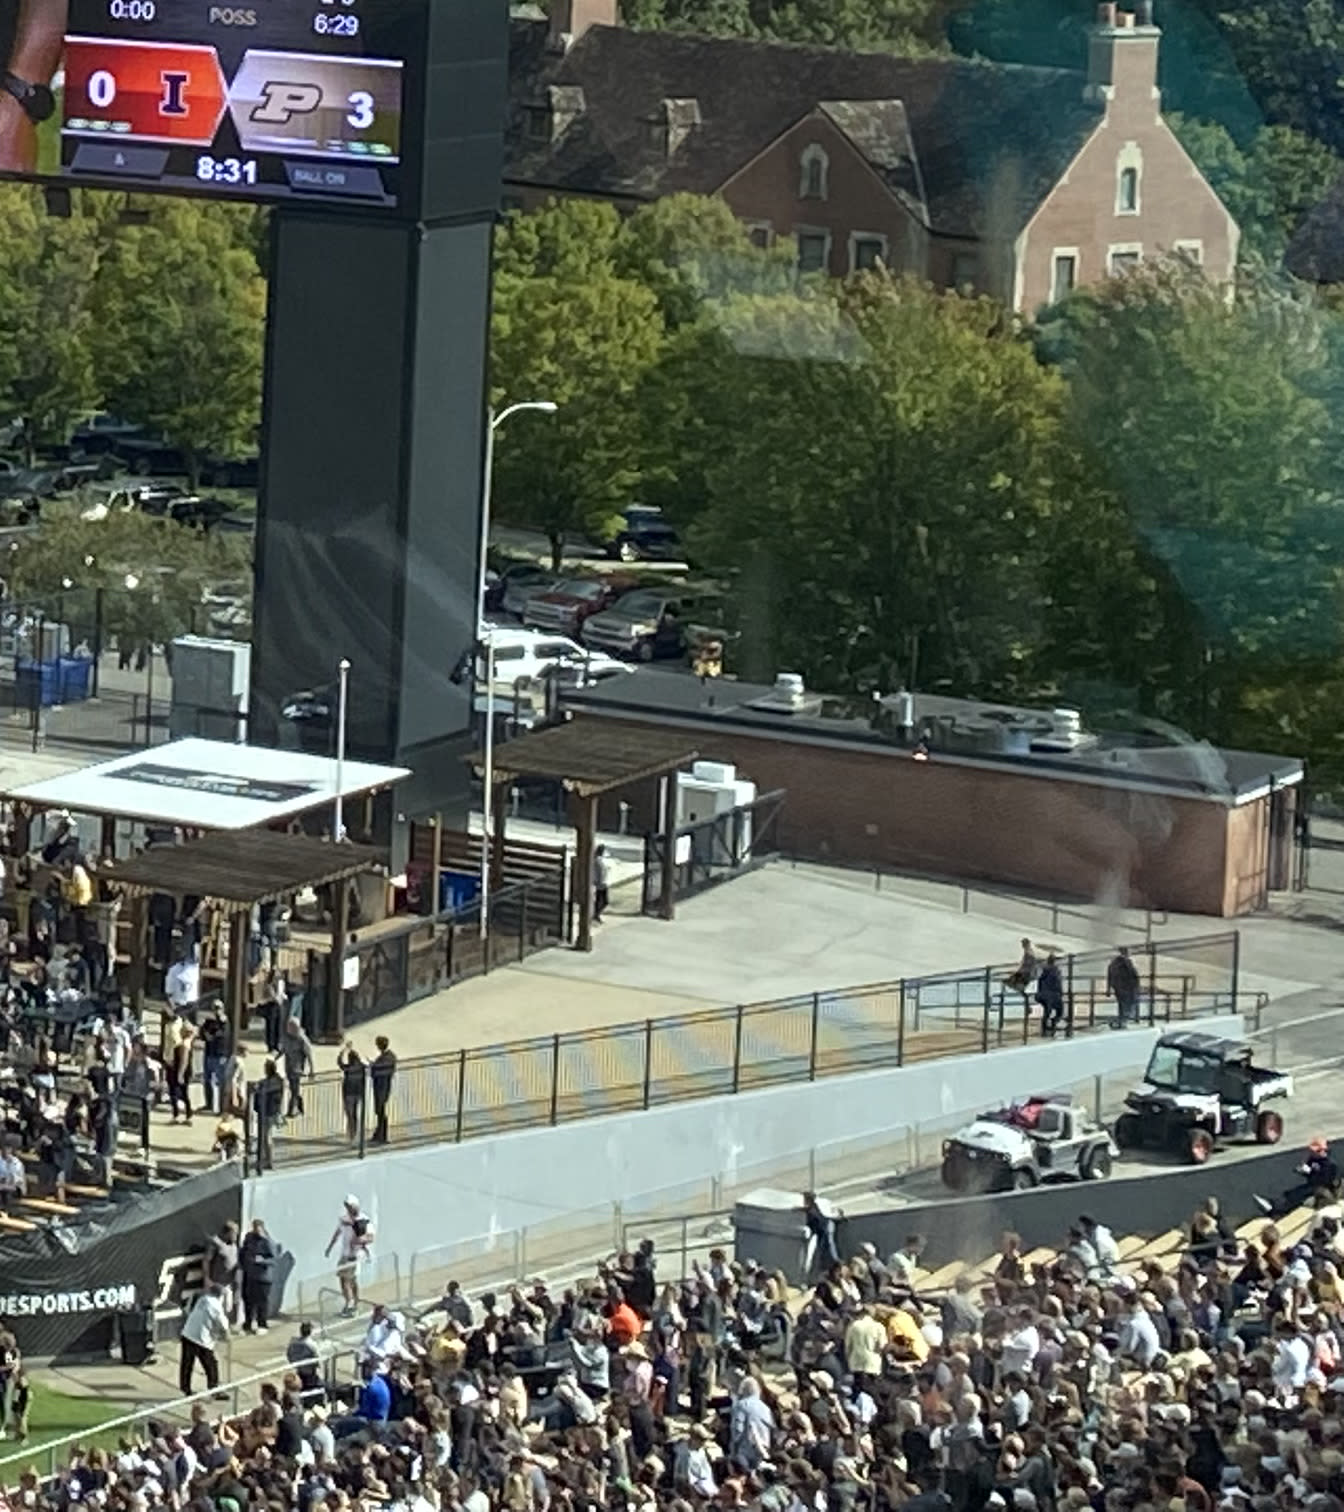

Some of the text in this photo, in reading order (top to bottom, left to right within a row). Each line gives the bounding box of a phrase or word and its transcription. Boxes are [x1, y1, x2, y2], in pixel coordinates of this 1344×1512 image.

[111, 0, 156, 22] 0:00
[209, 6, 258, 26] POSS
[314, 13, 359, 36] 6:29
[88, 70, 116, 108] 0
[347, 91, 375, 130] 3
[197, 156, 258, 184] 8:31
